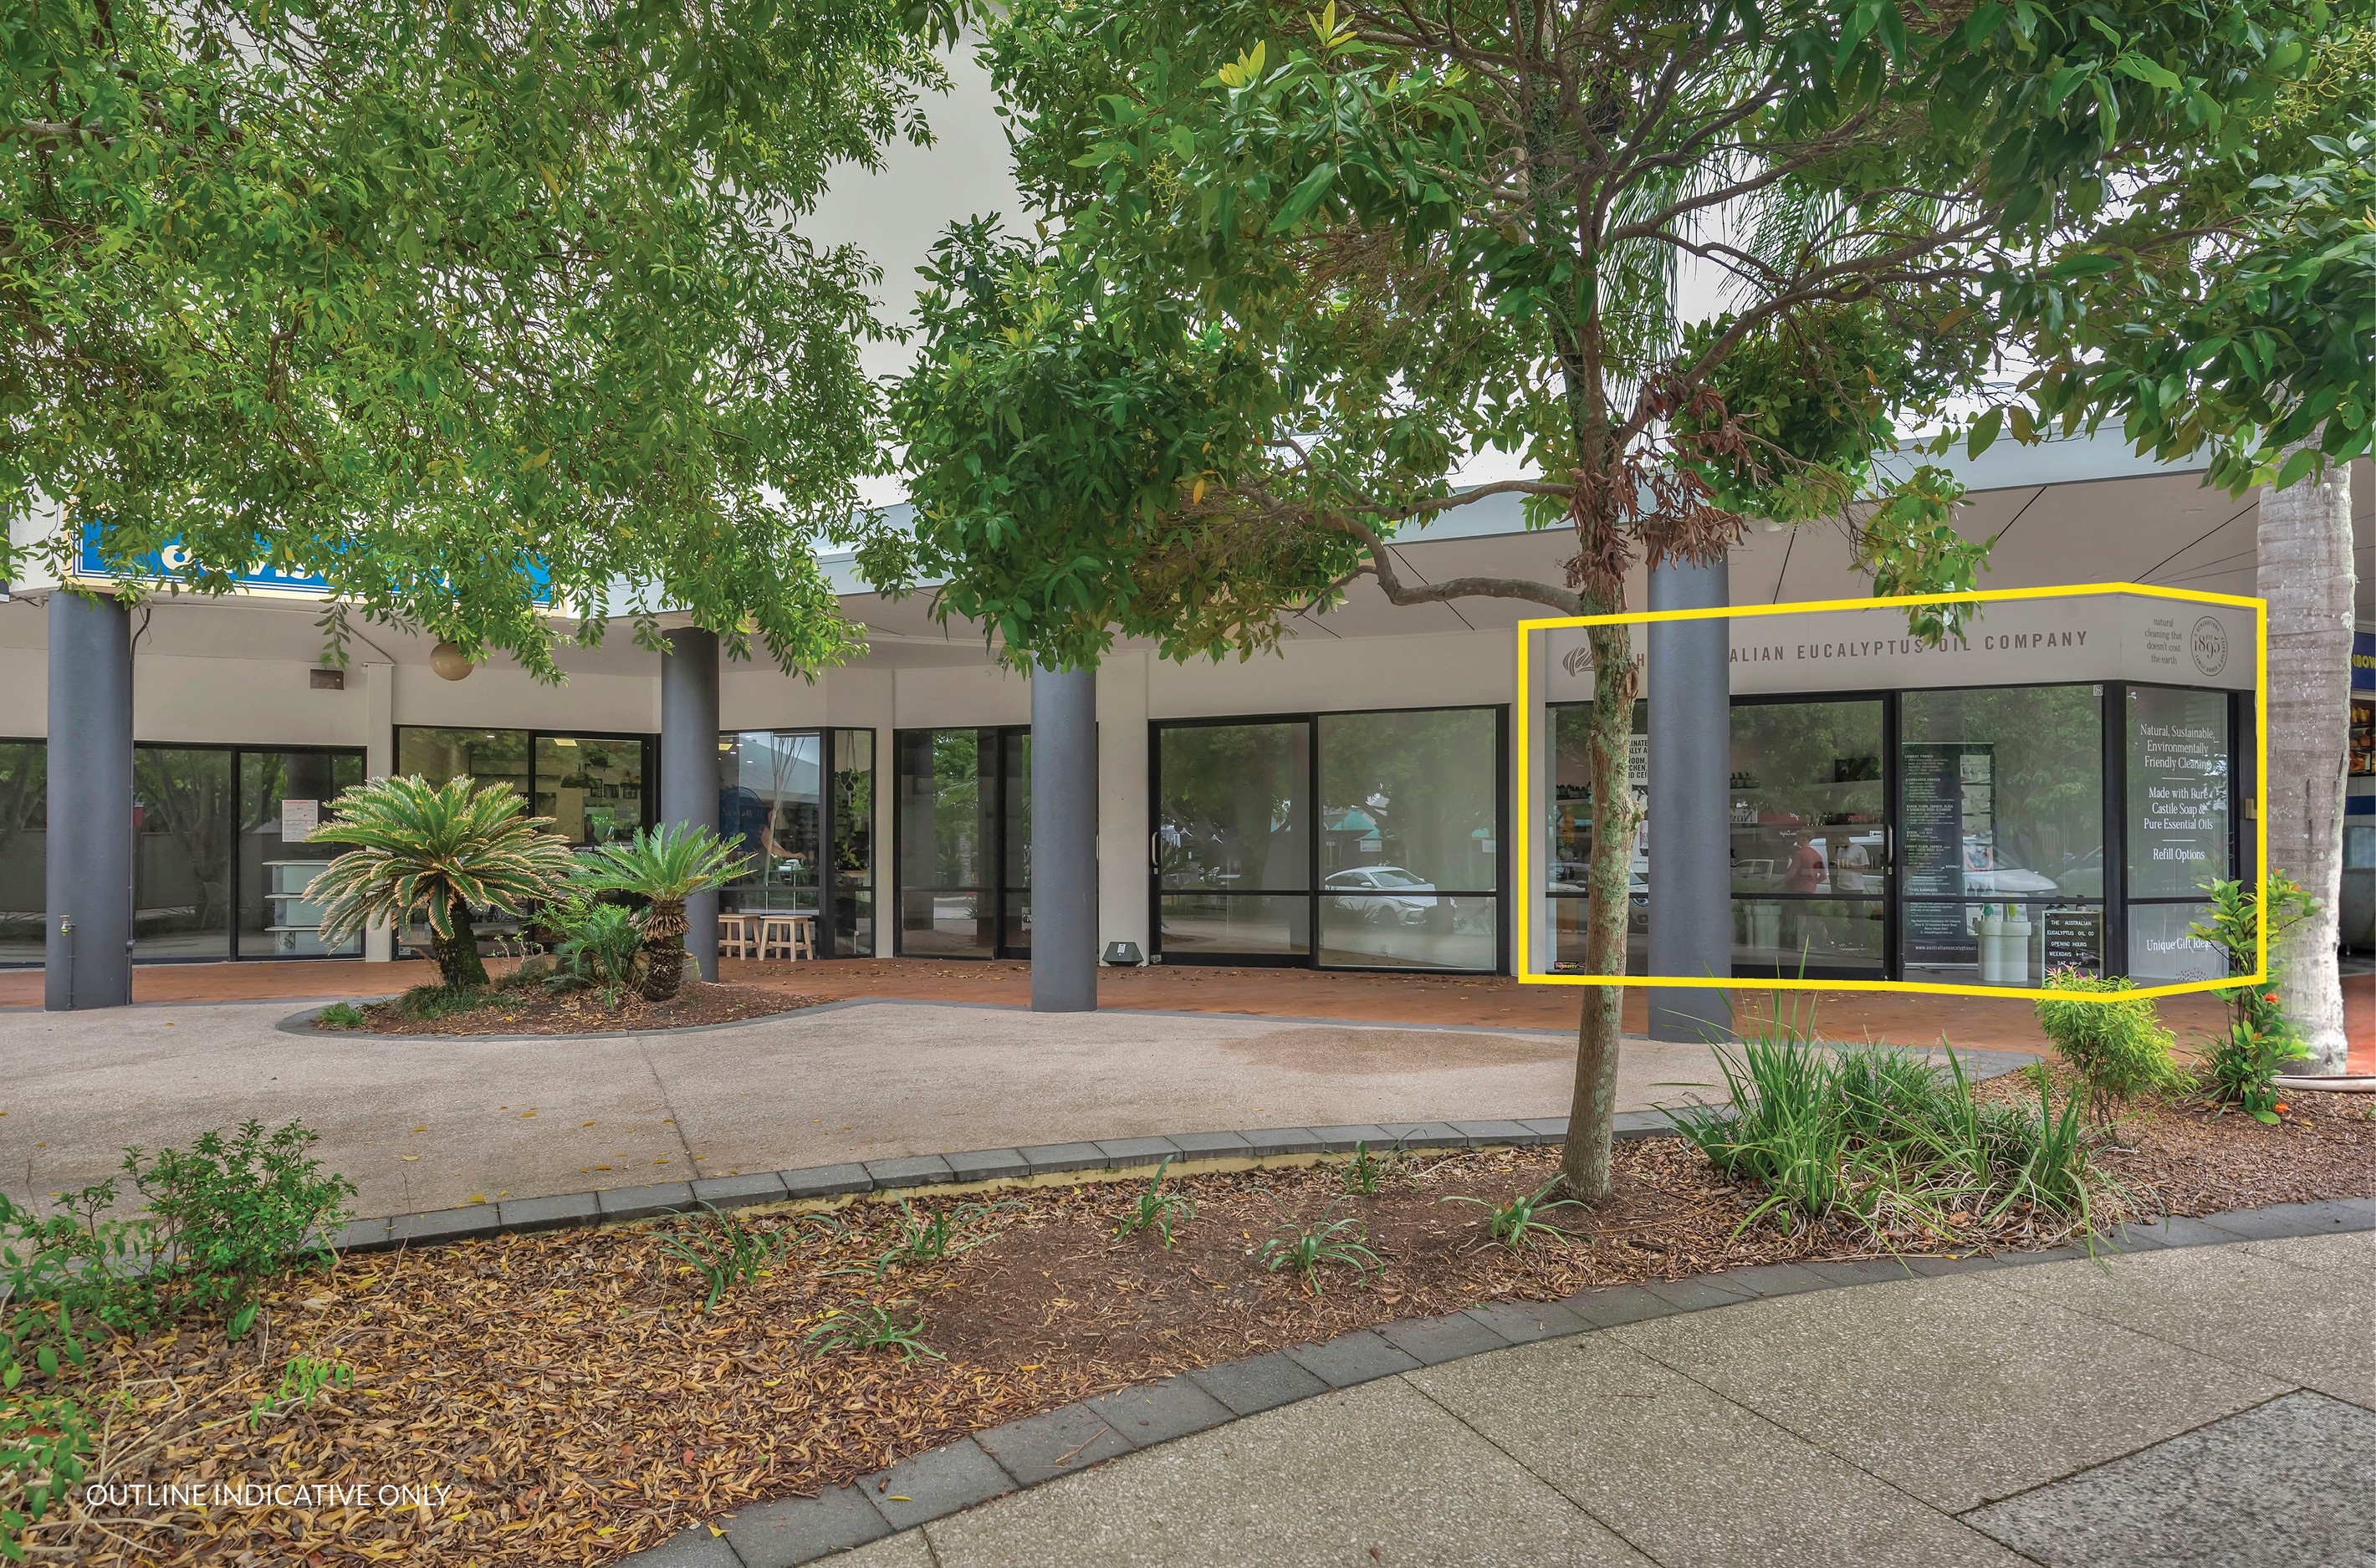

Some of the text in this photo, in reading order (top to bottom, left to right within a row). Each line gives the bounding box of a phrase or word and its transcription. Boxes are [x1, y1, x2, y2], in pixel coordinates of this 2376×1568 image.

[2154, 619, 2174, 627] natural
[2144, 629, 2182, 641] cleaning that
[1729, 631, 2087, 662] ALIAN EUCALYPTUS OIL COMPANY
[2147, 641, 2167, 651] doesn't
[2195, 635, 2220, 659] 1895
[2151, 654, 2177, 665] the earth
[2140, 723, 2215, 739] Natural, Sustainable,
[2147, 740, 2209, 754] Environmentally
[2144, 755, 2212, 772] Friendly Cleaning
[2149, 786, 2169, 799] Made
[2172, 787, 2189, 799] with
[2152, 802, 2205, 817] Castile Soap &
[2144, 818, 2213, 830] Pure Essential Oils
[2153, 848, 2205, 863] Refill Options
[2147, 937, 2212, 953] Unique Gift Ideas
